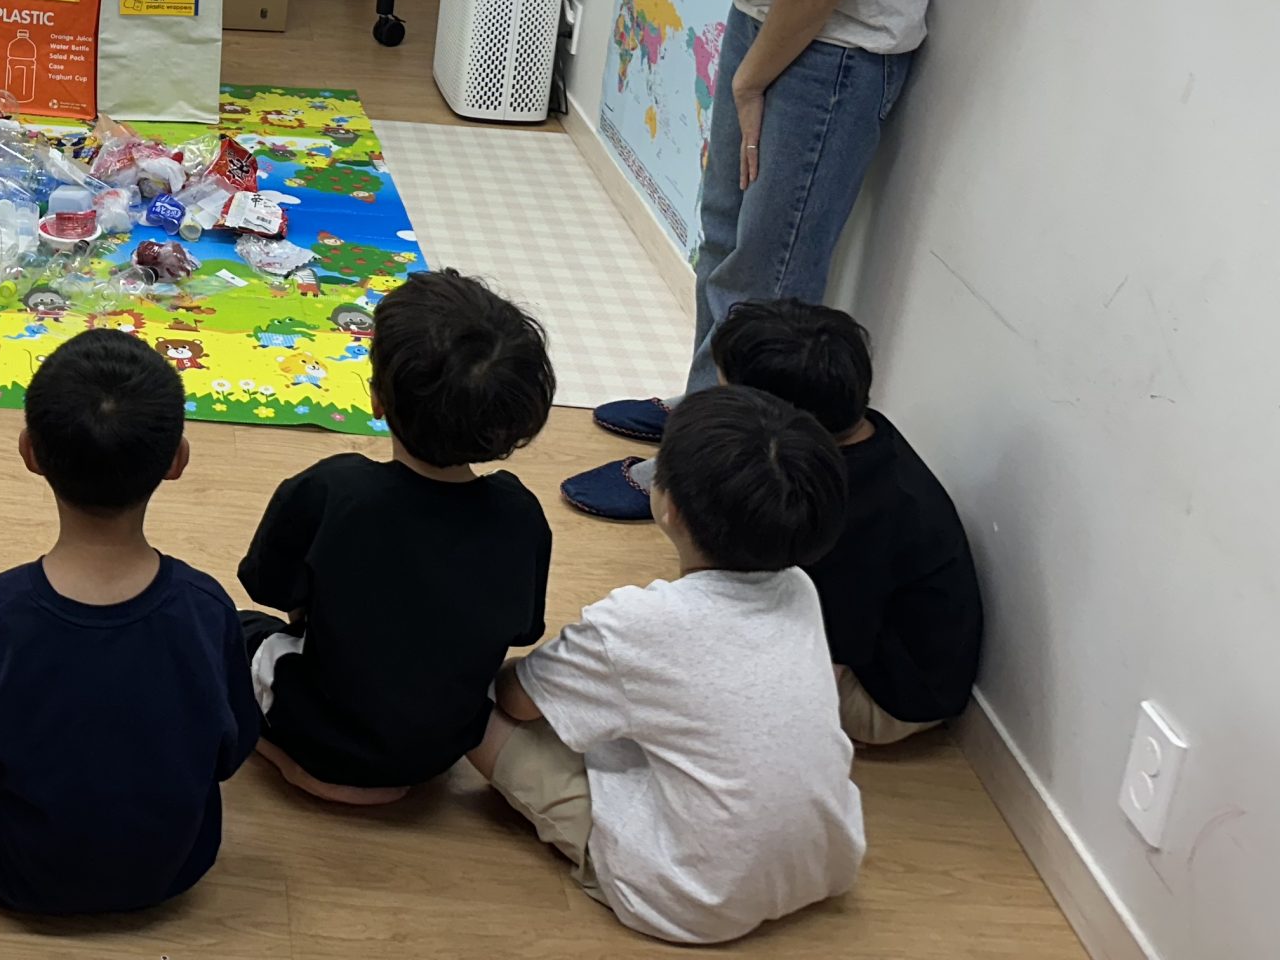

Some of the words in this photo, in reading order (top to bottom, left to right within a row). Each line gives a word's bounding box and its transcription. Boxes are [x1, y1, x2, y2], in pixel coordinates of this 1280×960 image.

[50, 33, 74, 41] Orange
[49, 52, 68, 60] Salad
[48, 73, 72, 82] Yoghurt
[75, 74, 88, 82] Cup
